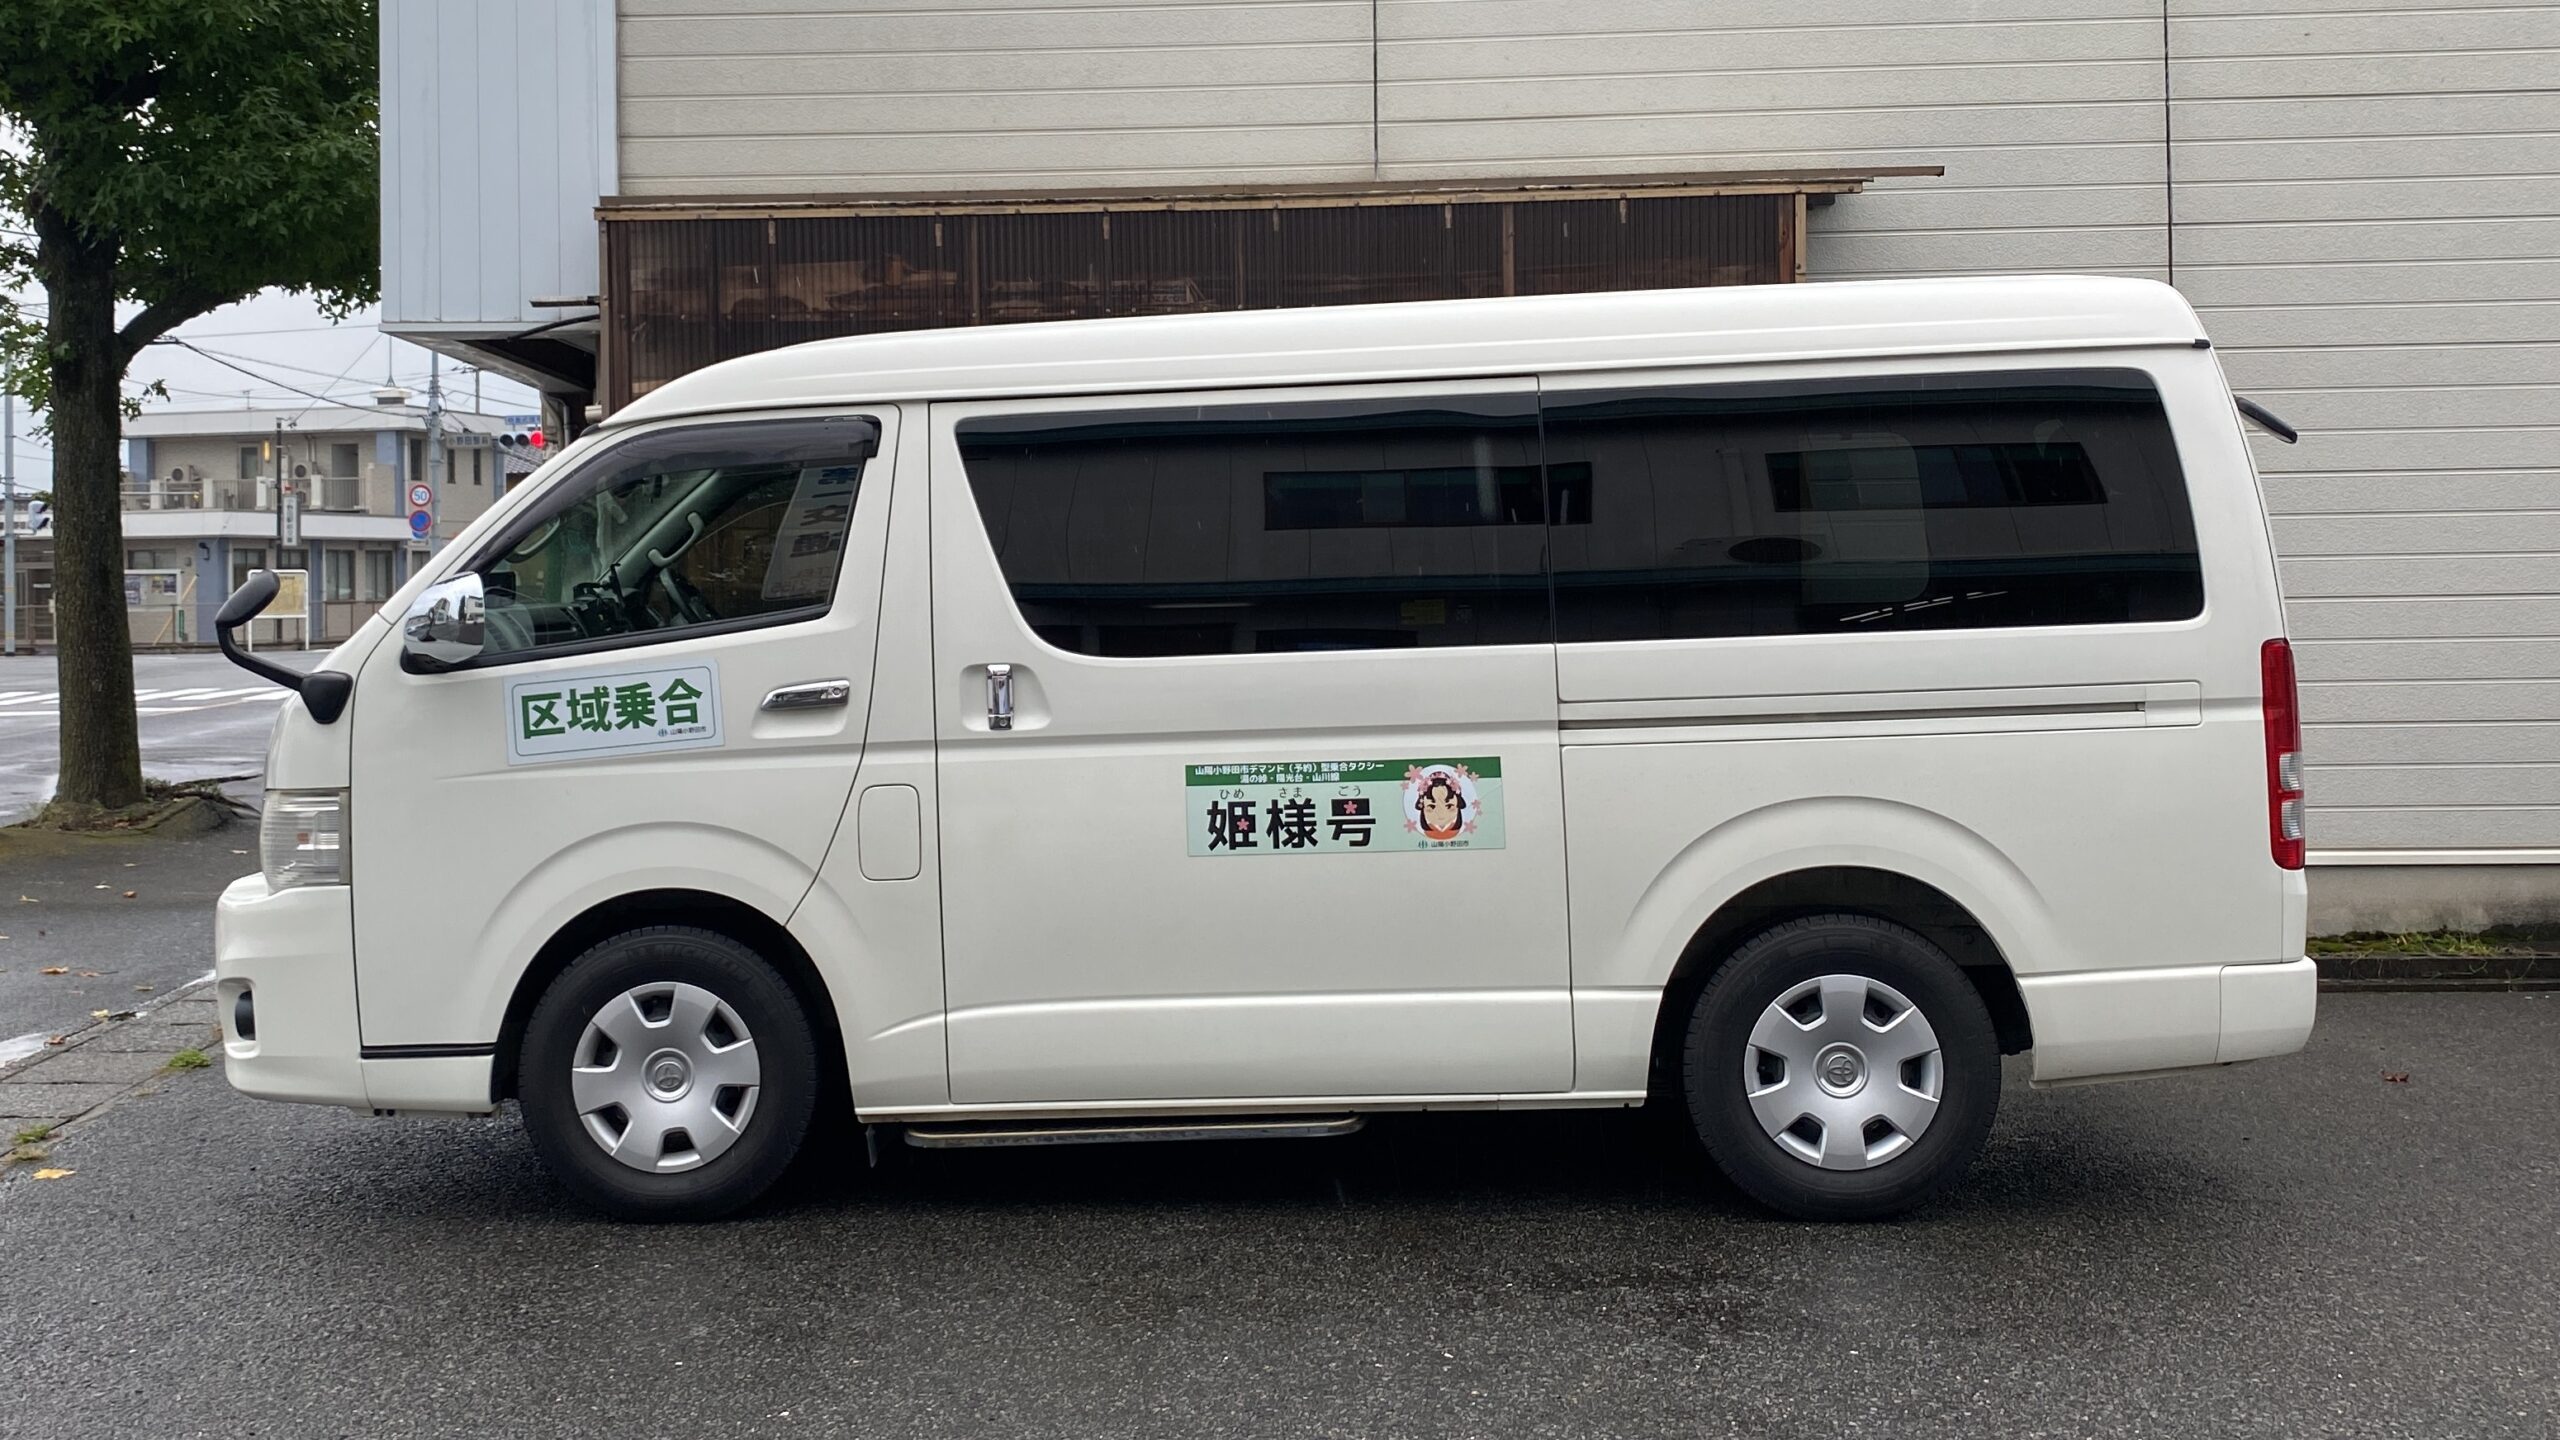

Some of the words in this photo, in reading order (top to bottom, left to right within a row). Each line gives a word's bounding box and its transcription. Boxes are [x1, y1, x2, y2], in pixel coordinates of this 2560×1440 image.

[414, 490, 428, 501] 50
[521, 677, 703, 740] 区域乗合
[1219, 788, 1245, 800] ひめ
[1278, 786, 1303, 798] さま
[1338, 785, 1362, 797] こう
[1206, 797, 1377, 851] 姫様号
[1430, 840, 1470, 848] 山陽小野田市
